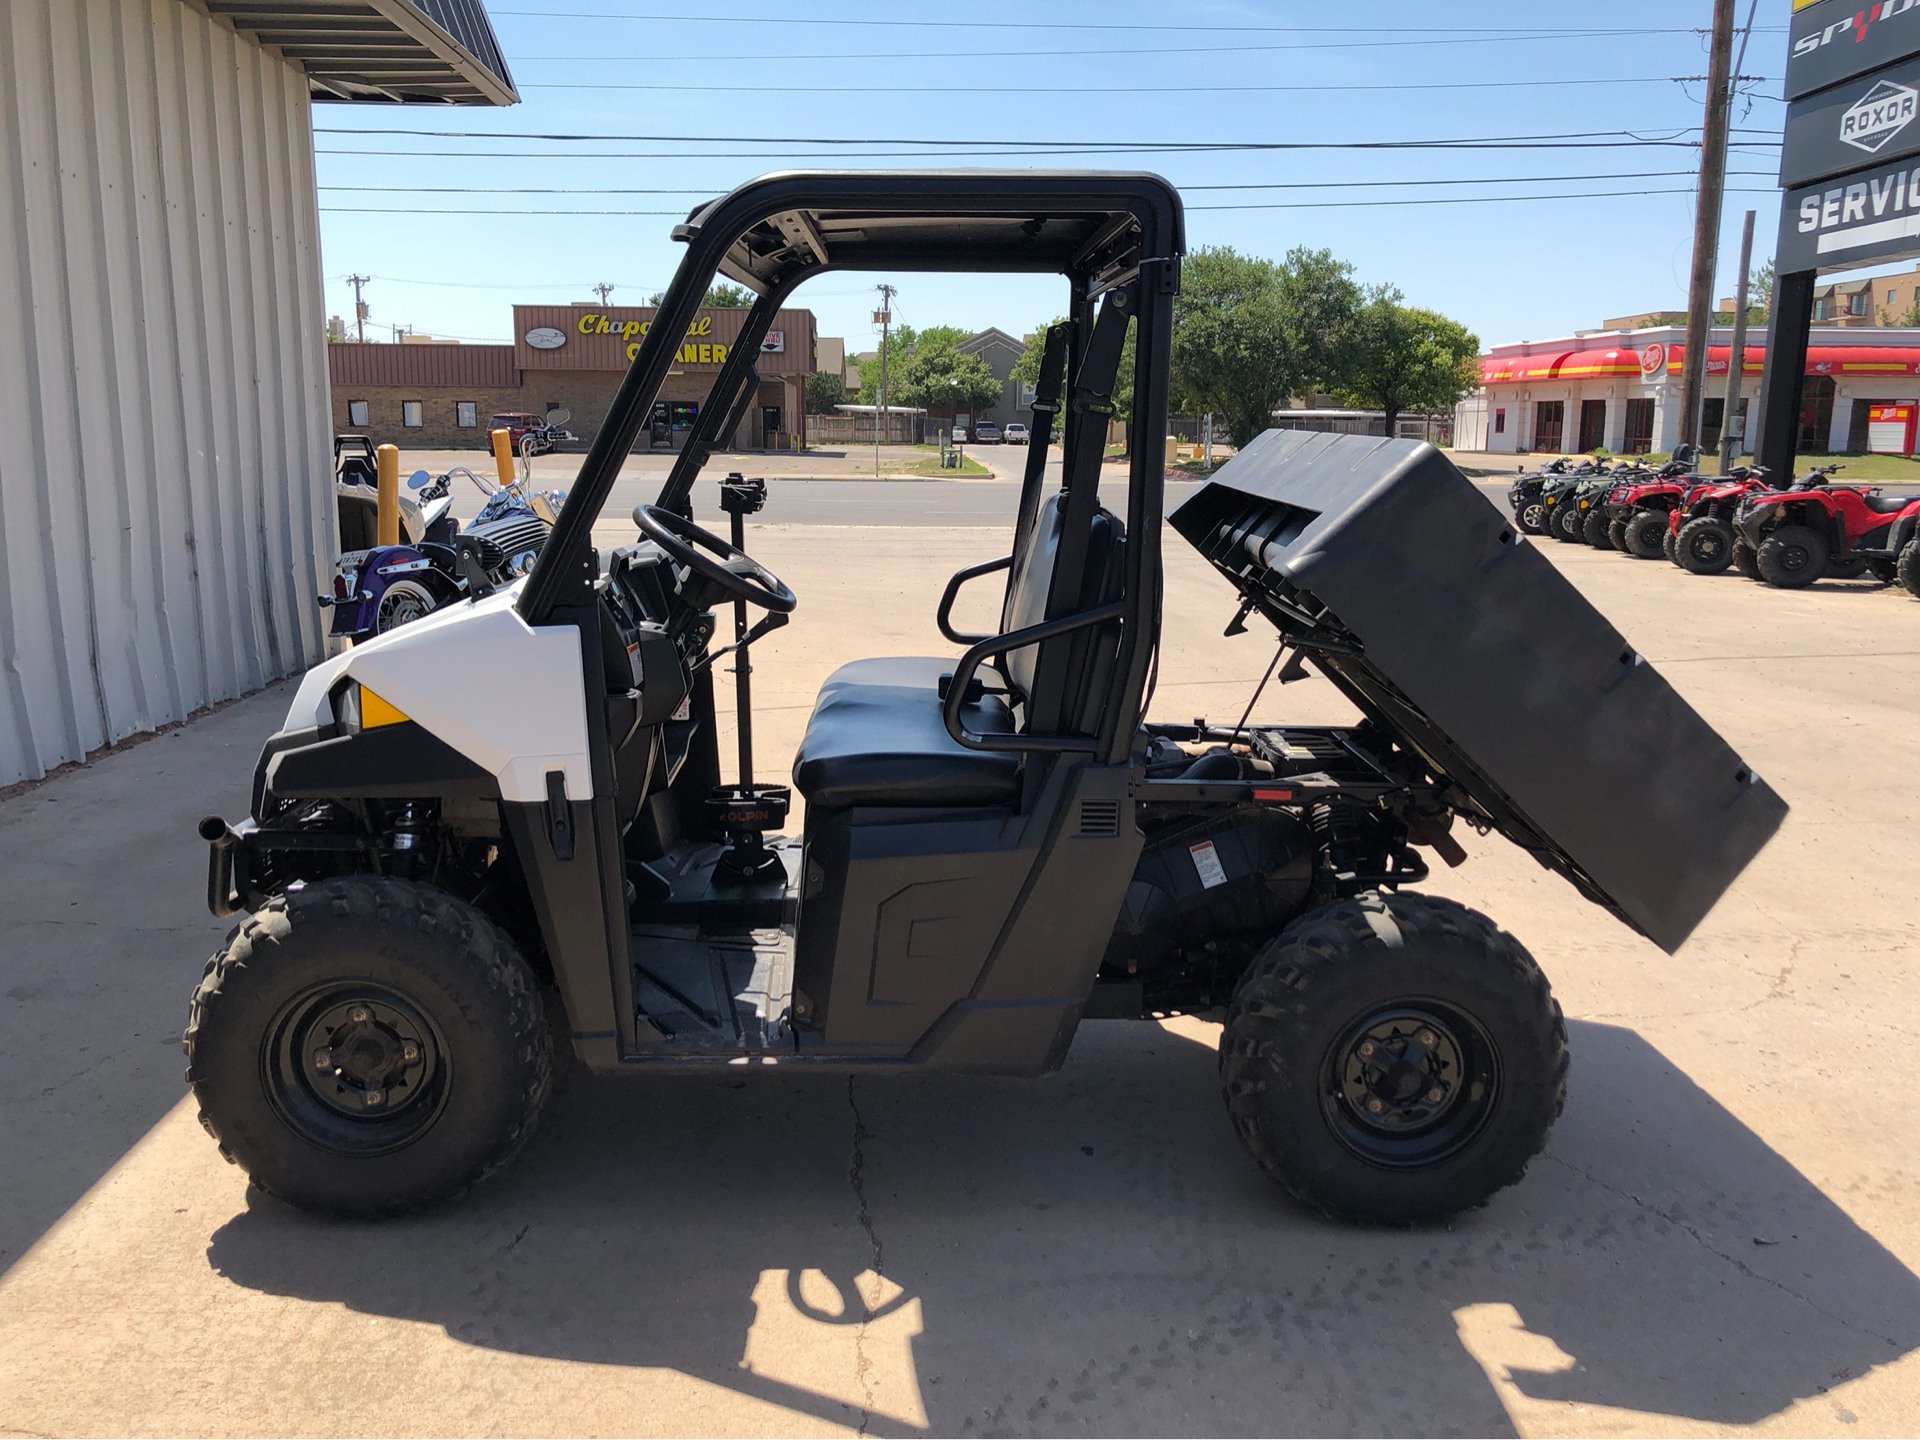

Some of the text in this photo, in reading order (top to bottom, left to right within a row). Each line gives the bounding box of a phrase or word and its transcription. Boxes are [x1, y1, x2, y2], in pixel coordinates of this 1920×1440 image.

[1792, 0, 1920, 58] SPYD
[1843, 96, 1913, 136] ROXOR
[626, 342, 734, 363] CANER
